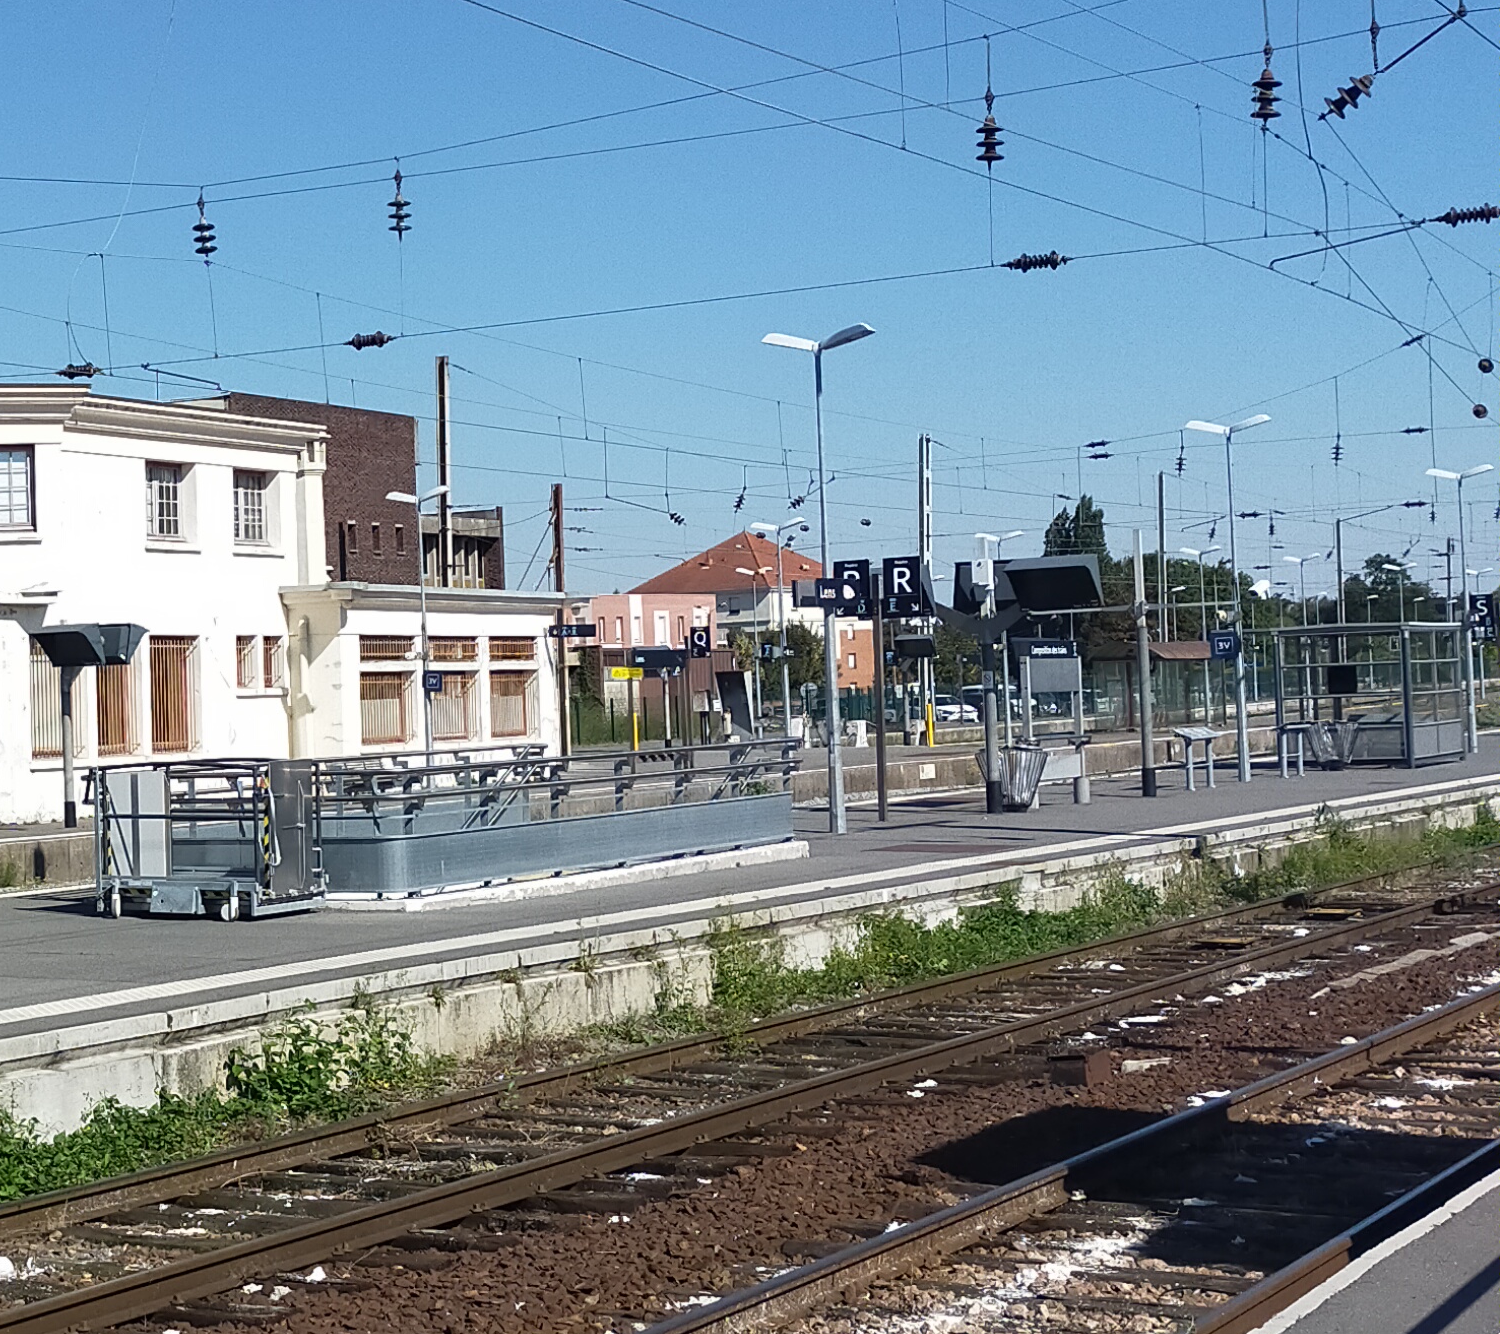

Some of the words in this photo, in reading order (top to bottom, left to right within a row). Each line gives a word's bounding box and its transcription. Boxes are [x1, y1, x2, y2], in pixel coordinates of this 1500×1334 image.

[893, 568, 912, 593] R
[1476, 600, 1488, 616] S
[694, 631, 706, 647] Q
[1218, 642, 1230, 650] 3V
